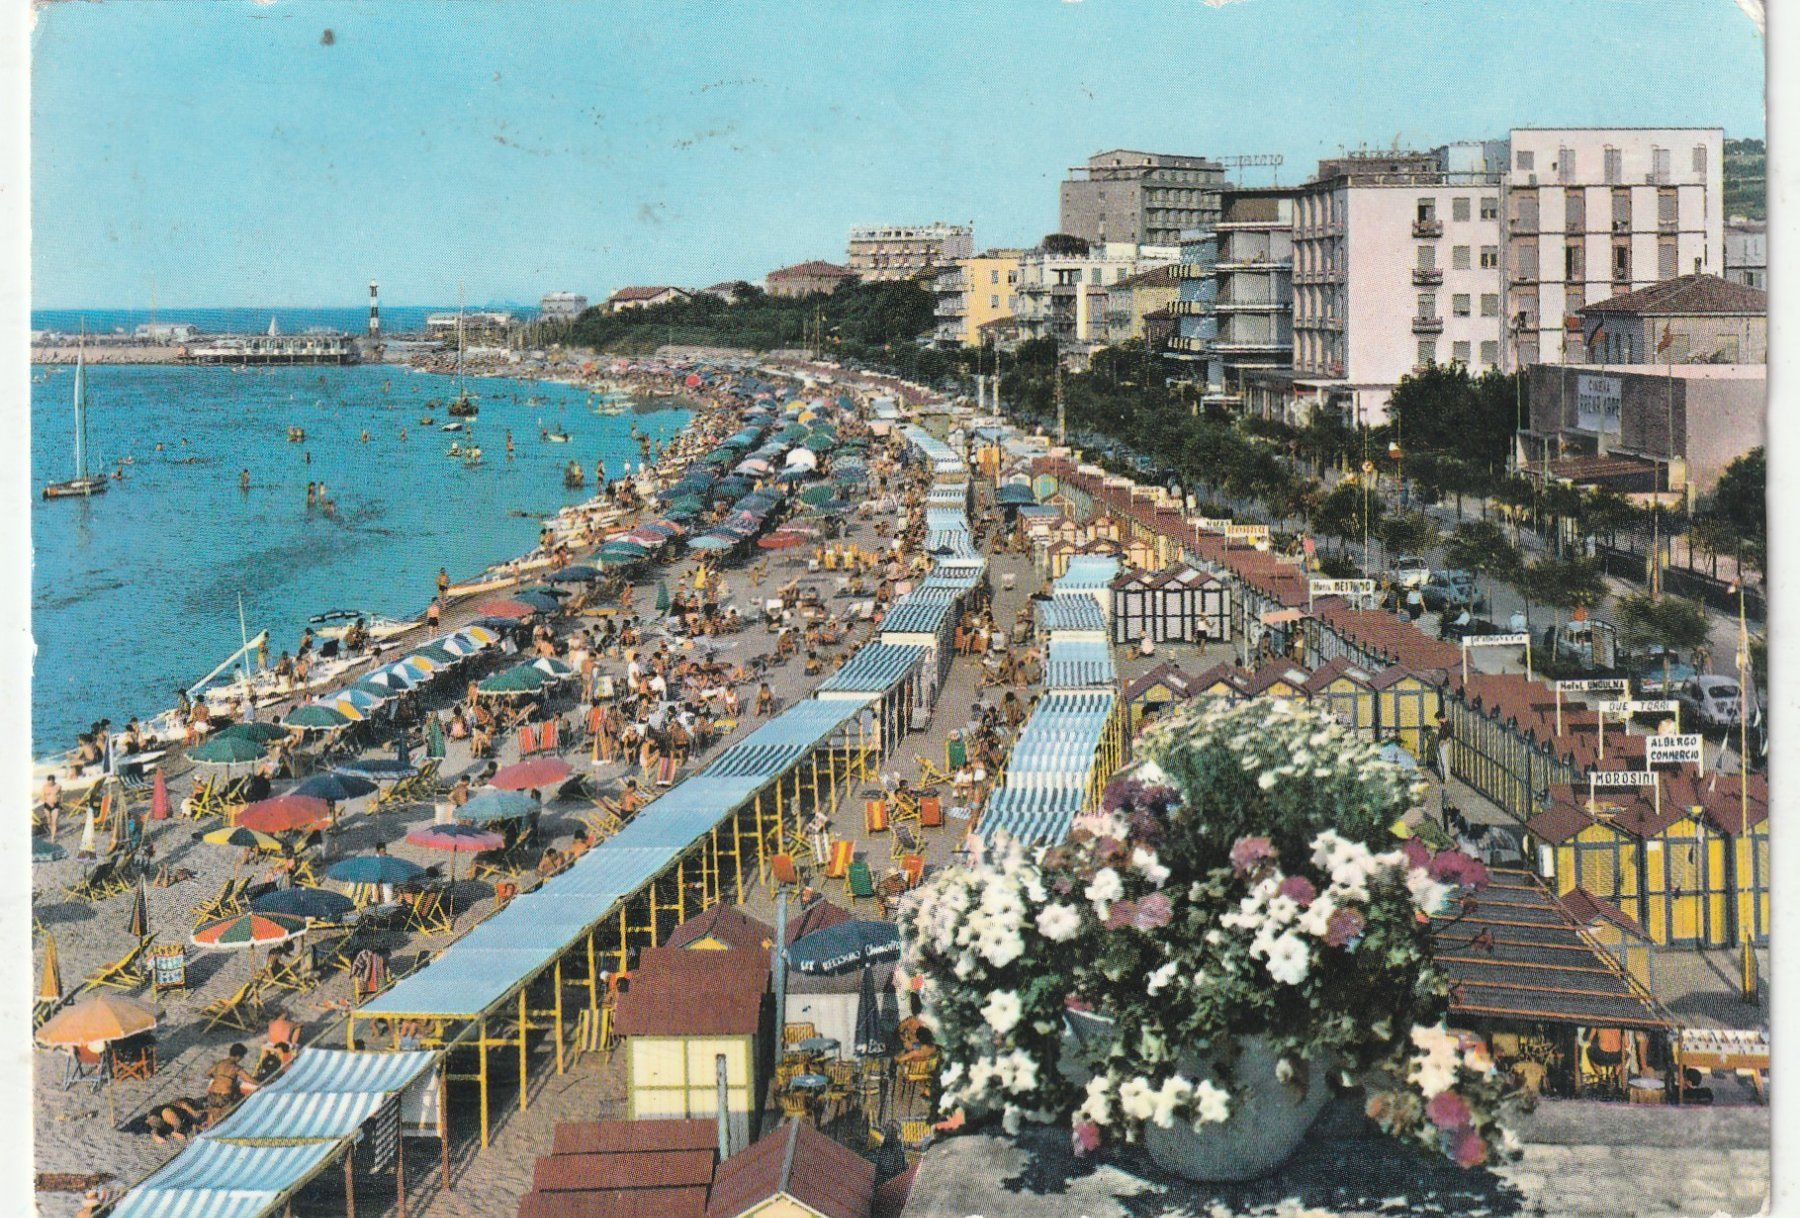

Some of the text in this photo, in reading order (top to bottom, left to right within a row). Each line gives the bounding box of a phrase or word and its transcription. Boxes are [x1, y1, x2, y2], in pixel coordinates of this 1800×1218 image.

[1650, 736, 1697, 747] ALBERGO
[1650, 750, 1699, 760] COMMERCIO
[1595, 773, 1655, 784] MOROSINI
